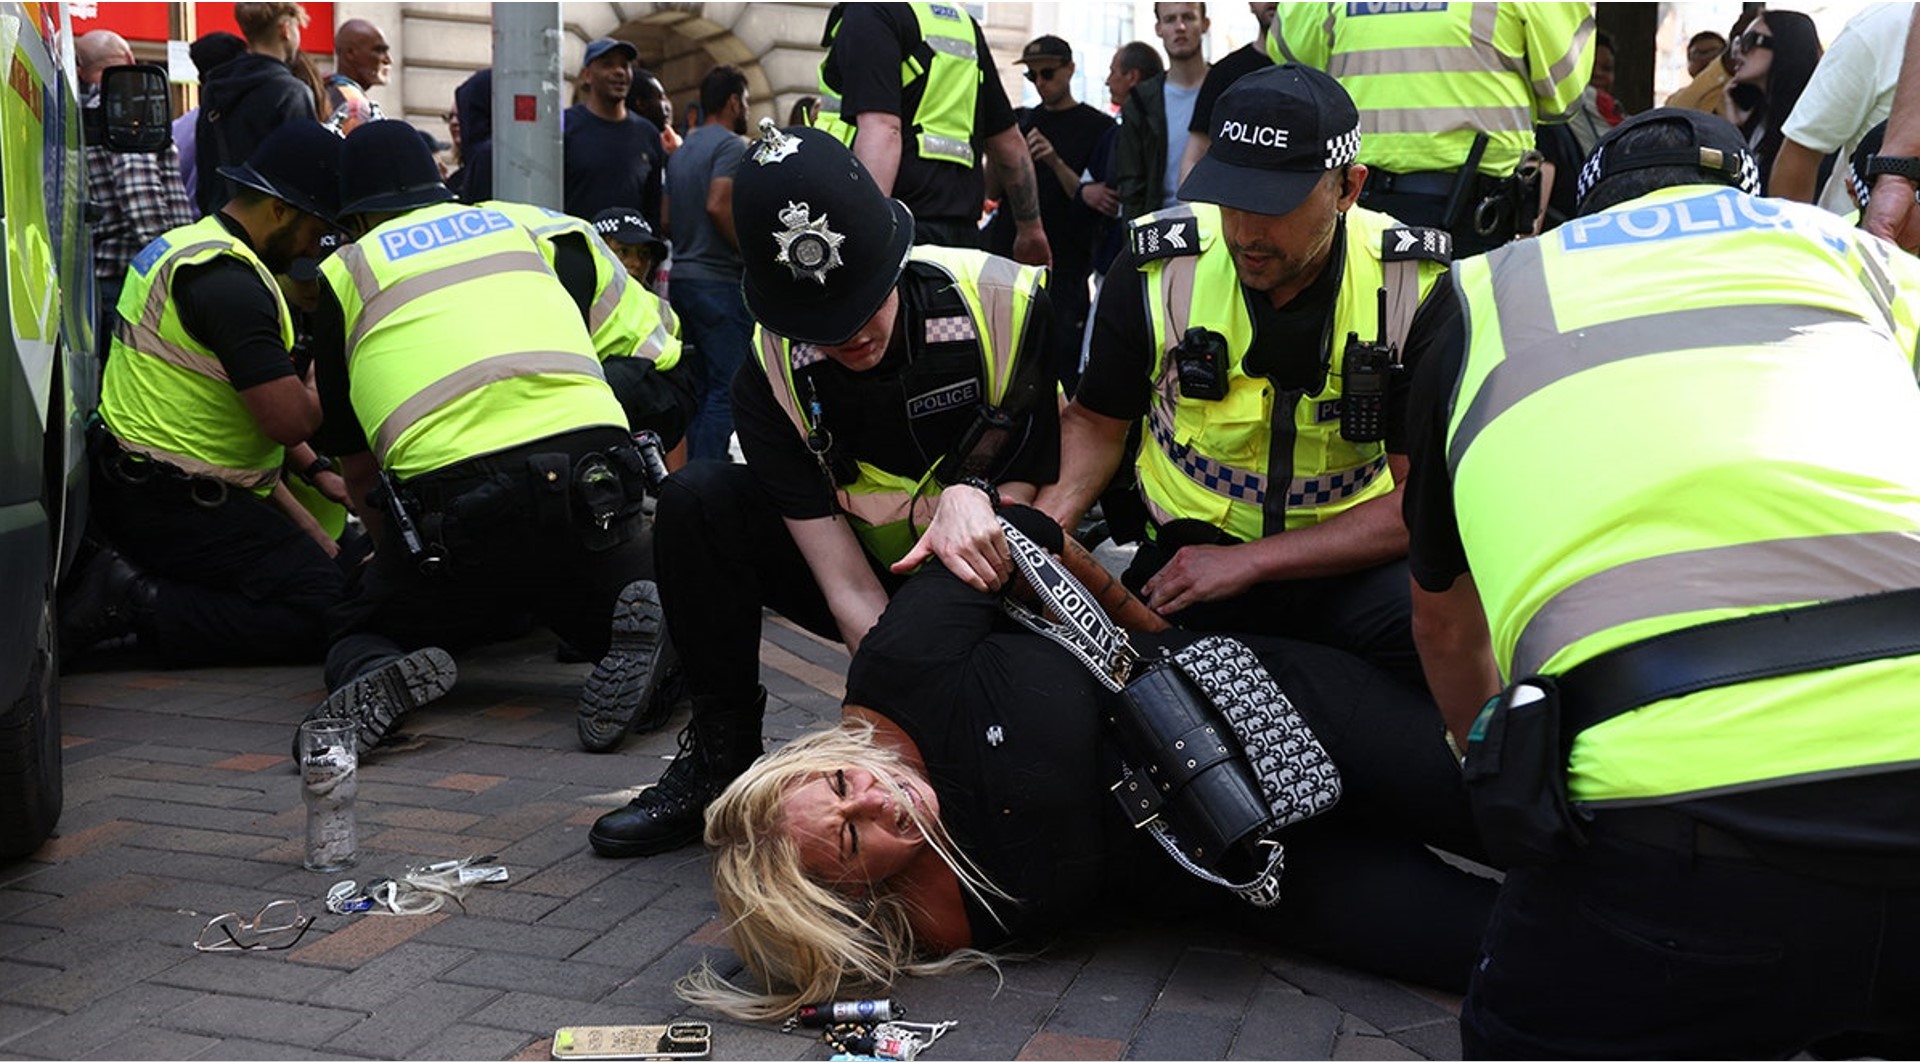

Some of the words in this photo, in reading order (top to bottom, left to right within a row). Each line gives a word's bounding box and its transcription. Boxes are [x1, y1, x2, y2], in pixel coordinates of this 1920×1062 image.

[1219, 120, 1289, 149] POLICE
[385, 209, 509, 258] POLICE
[1572, 193, 1785, 243] POLIC
[913, 385, 974, 413] POLICE
[1051, 579, 1097, 631] DIOR
